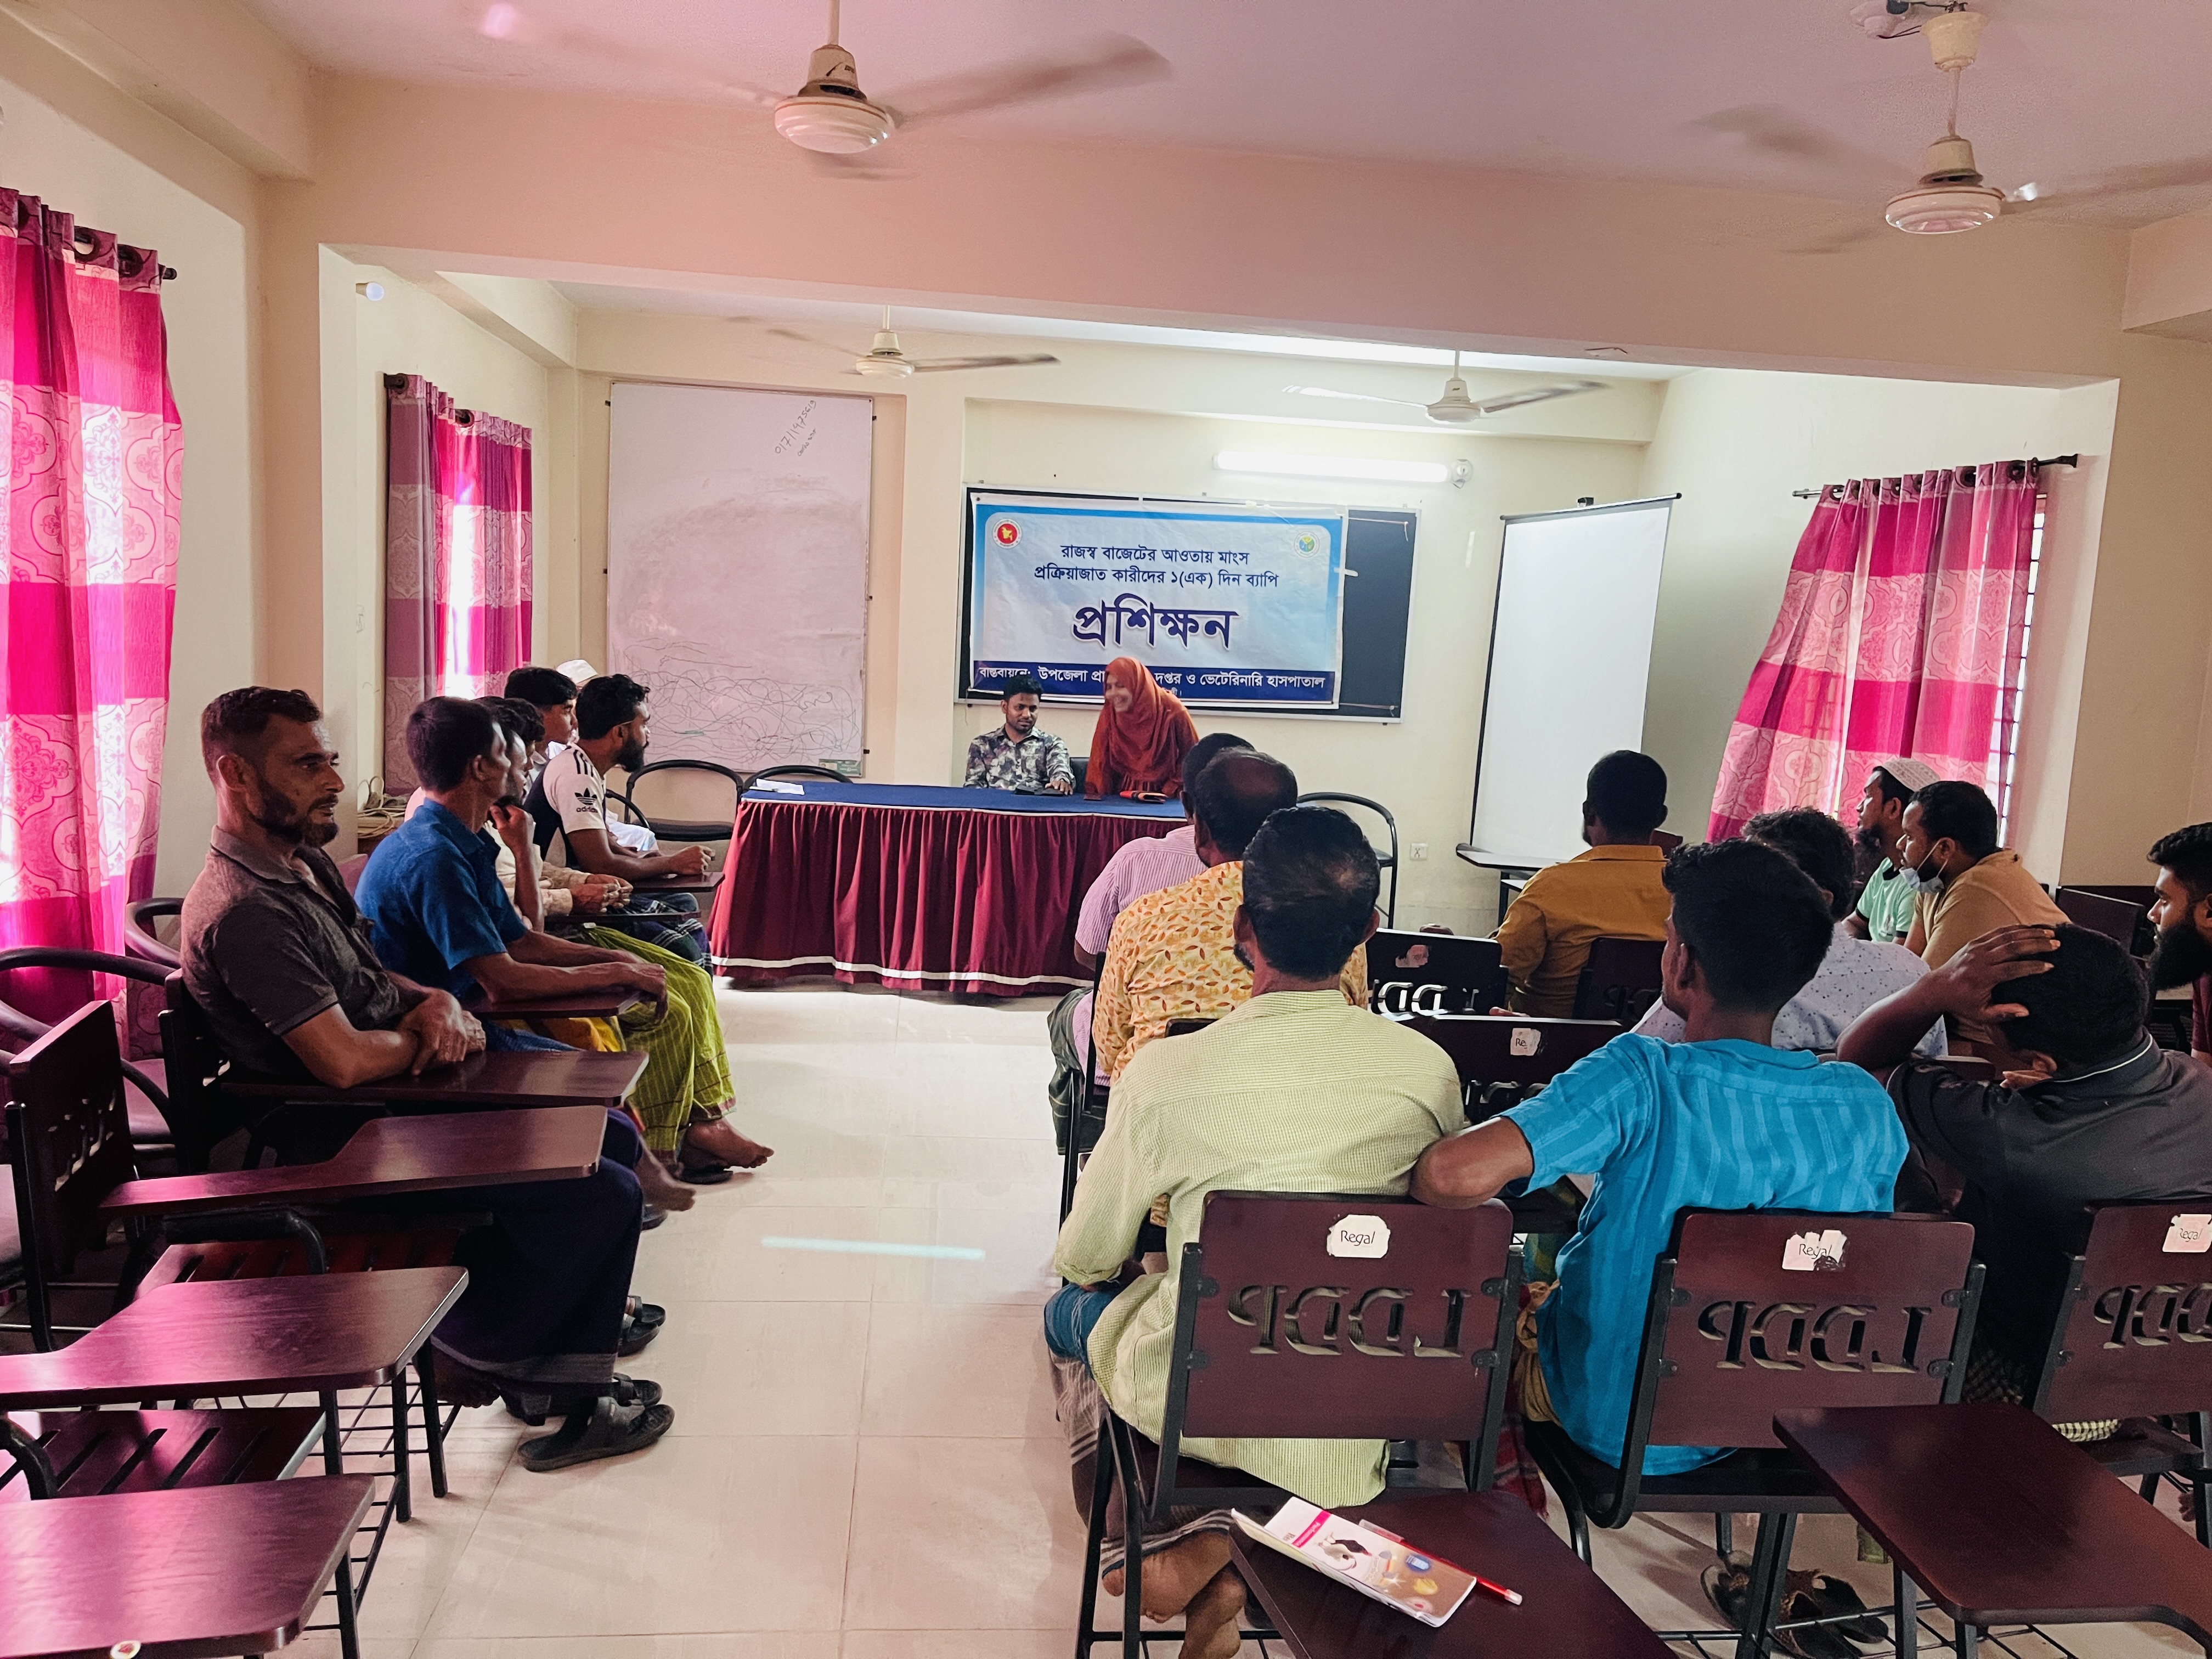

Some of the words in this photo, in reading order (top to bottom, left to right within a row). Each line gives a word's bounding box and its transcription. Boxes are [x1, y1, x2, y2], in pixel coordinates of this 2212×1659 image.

[1060, 545, 1098, 560] রাজস্ব
[1101, 544, 1156, 561] বাজেটের
[1161, 549, 1214, 564] আওতায়
[1217, 550, 1250, 565] মাংস
[1034, 562, 1108, 582] প্রক্রিয়াজাত
[1111, 566, 1166, 584] কারীদের
[1217, 569, 1243, 586] দিন
[1246, 571, 1279, 588] ব্যাপি
[1073, 592, 1239, 648] প্রশিক্ষন
[1037, 665, 1088, 682] উপজেলা
[1154, 672, 1182, 685] দপ্তর
[1186, 674, 1195, 685] ও
[1200, 670, 1263, 687] ভেটেরিনারি
[1266, 674, 1325, 689] হাসপাতাল
[1341, 1230, 1375, 1246] Regal
